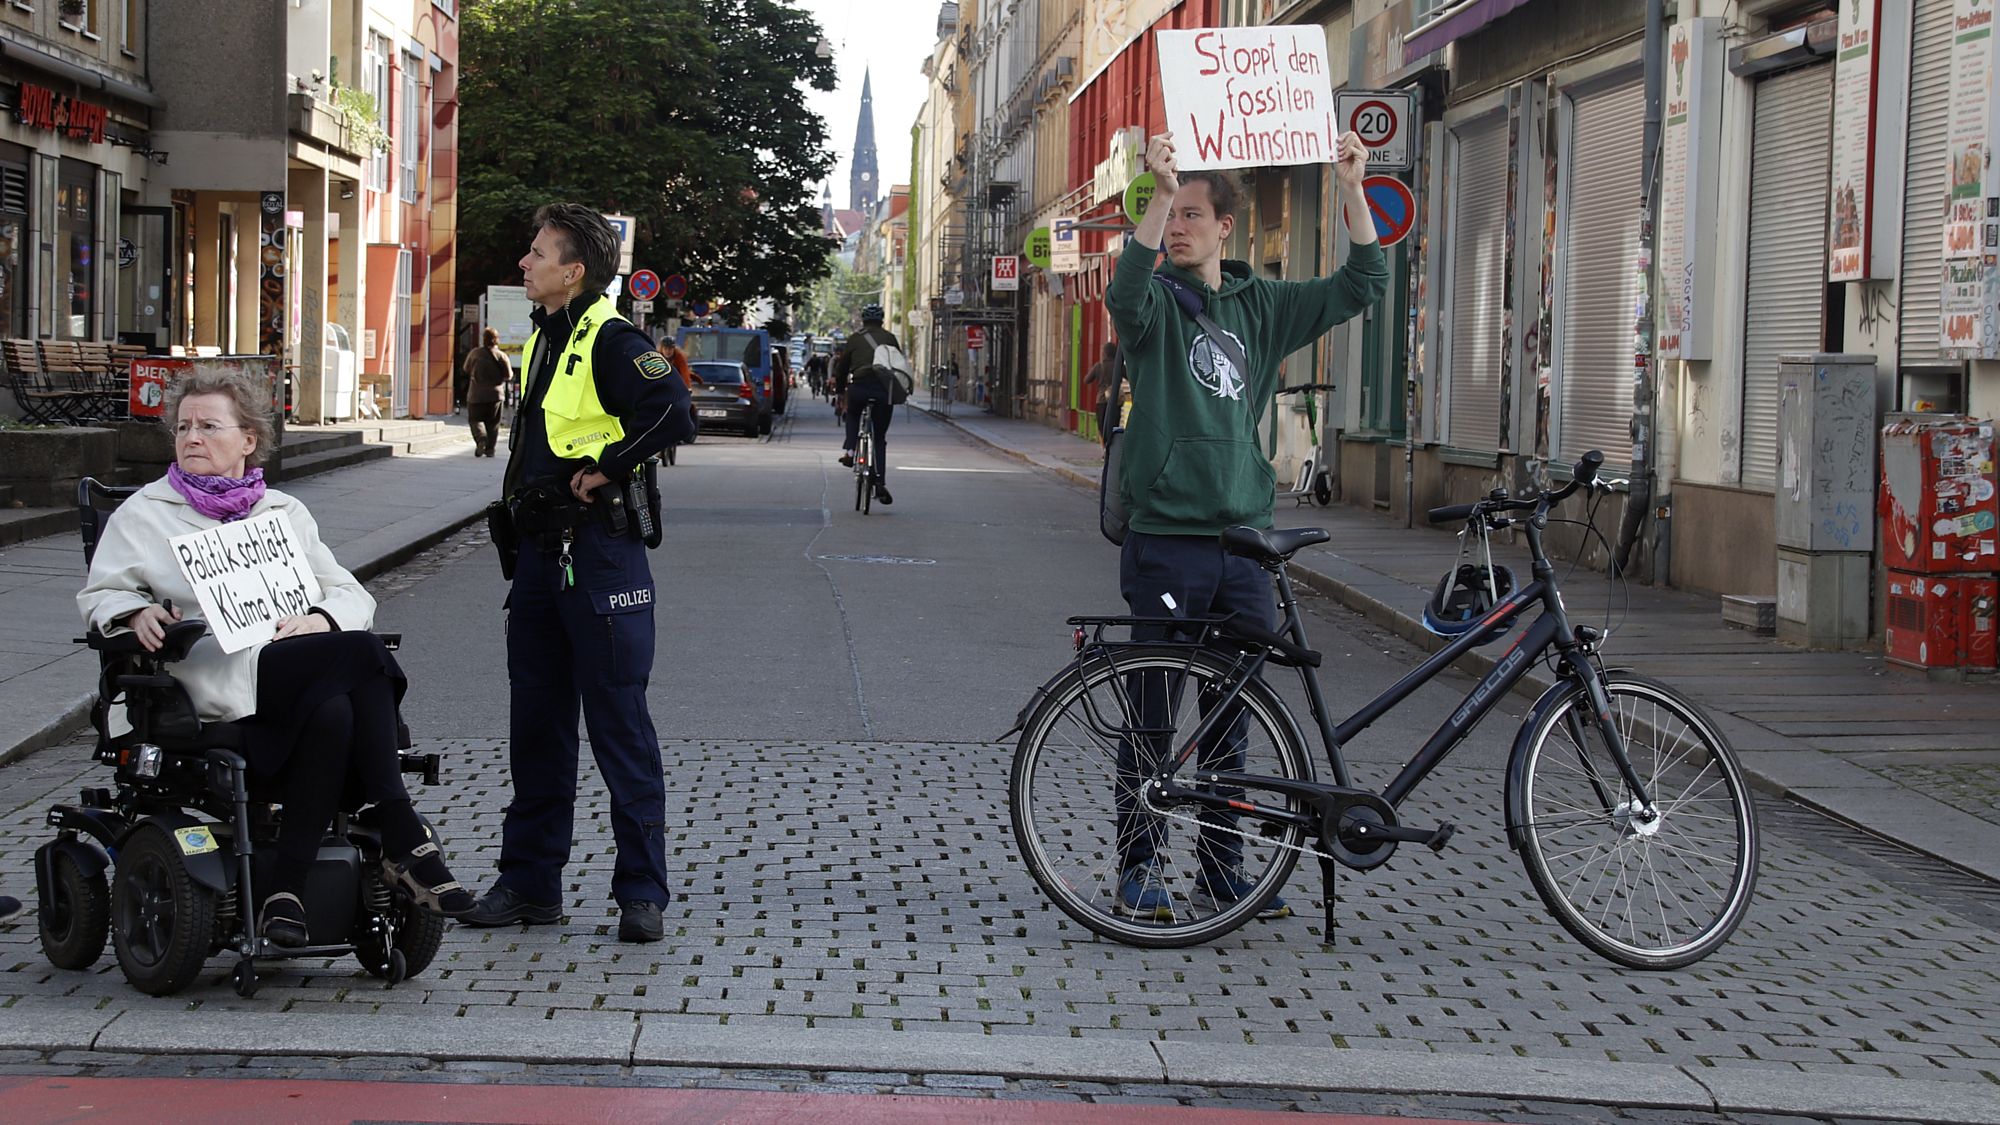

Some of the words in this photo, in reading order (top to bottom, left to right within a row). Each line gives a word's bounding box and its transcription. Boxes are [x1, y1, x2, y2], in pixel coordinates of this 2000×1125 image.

[1194, 31, 1279, 77] Stoppt
[1288, 35, 1321, 75] den
[1226, 76, 1315, 117] fossilen
[1360, 112, 1389, 134] 20
[1366, 150, 1390, 162] NE
[262, 200, 284, 208] ROYAL
[1136, 196, 1152, 215] B
[1033, 244, 1050, 258] Bi
[136, 364, 168, 380] BIER
[571, 431, 603, 447] POLIZEI
[177, 528, 241, 585] Politik
[237, 516, 295, 569] schläft
[208, 581, 272, 634] Klima
[609, 589, 652, 609] POLIZEI
